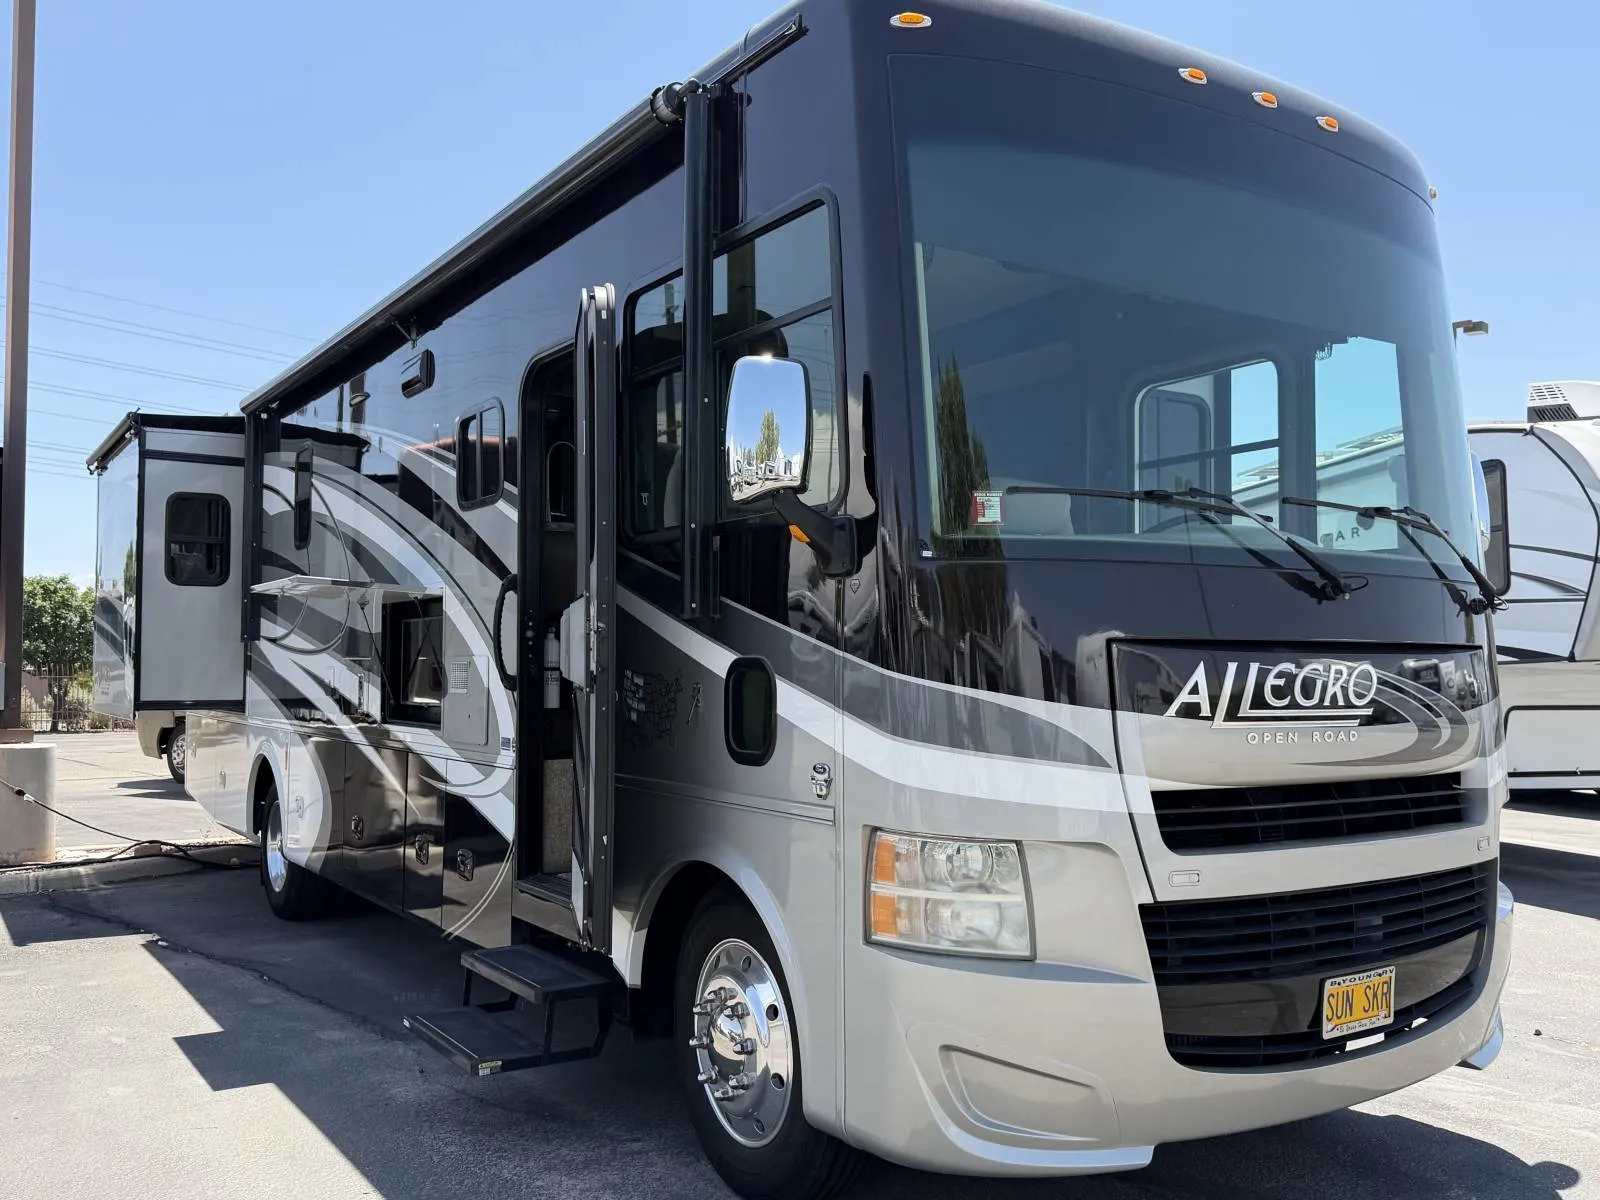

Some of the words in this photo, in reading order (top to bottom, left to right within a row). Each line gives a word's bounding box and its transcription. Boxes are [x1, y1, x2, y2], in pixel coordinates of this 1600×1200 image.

[1163, 660, 1378, 728] ALLEGRO
[1247, 732, 1298, 744] OPEN
[1312, 730, 1359, 743] ROAD
[1326, 988, 1354, 1022] SUN
[1363, 981, 1390, 1013] SKR
